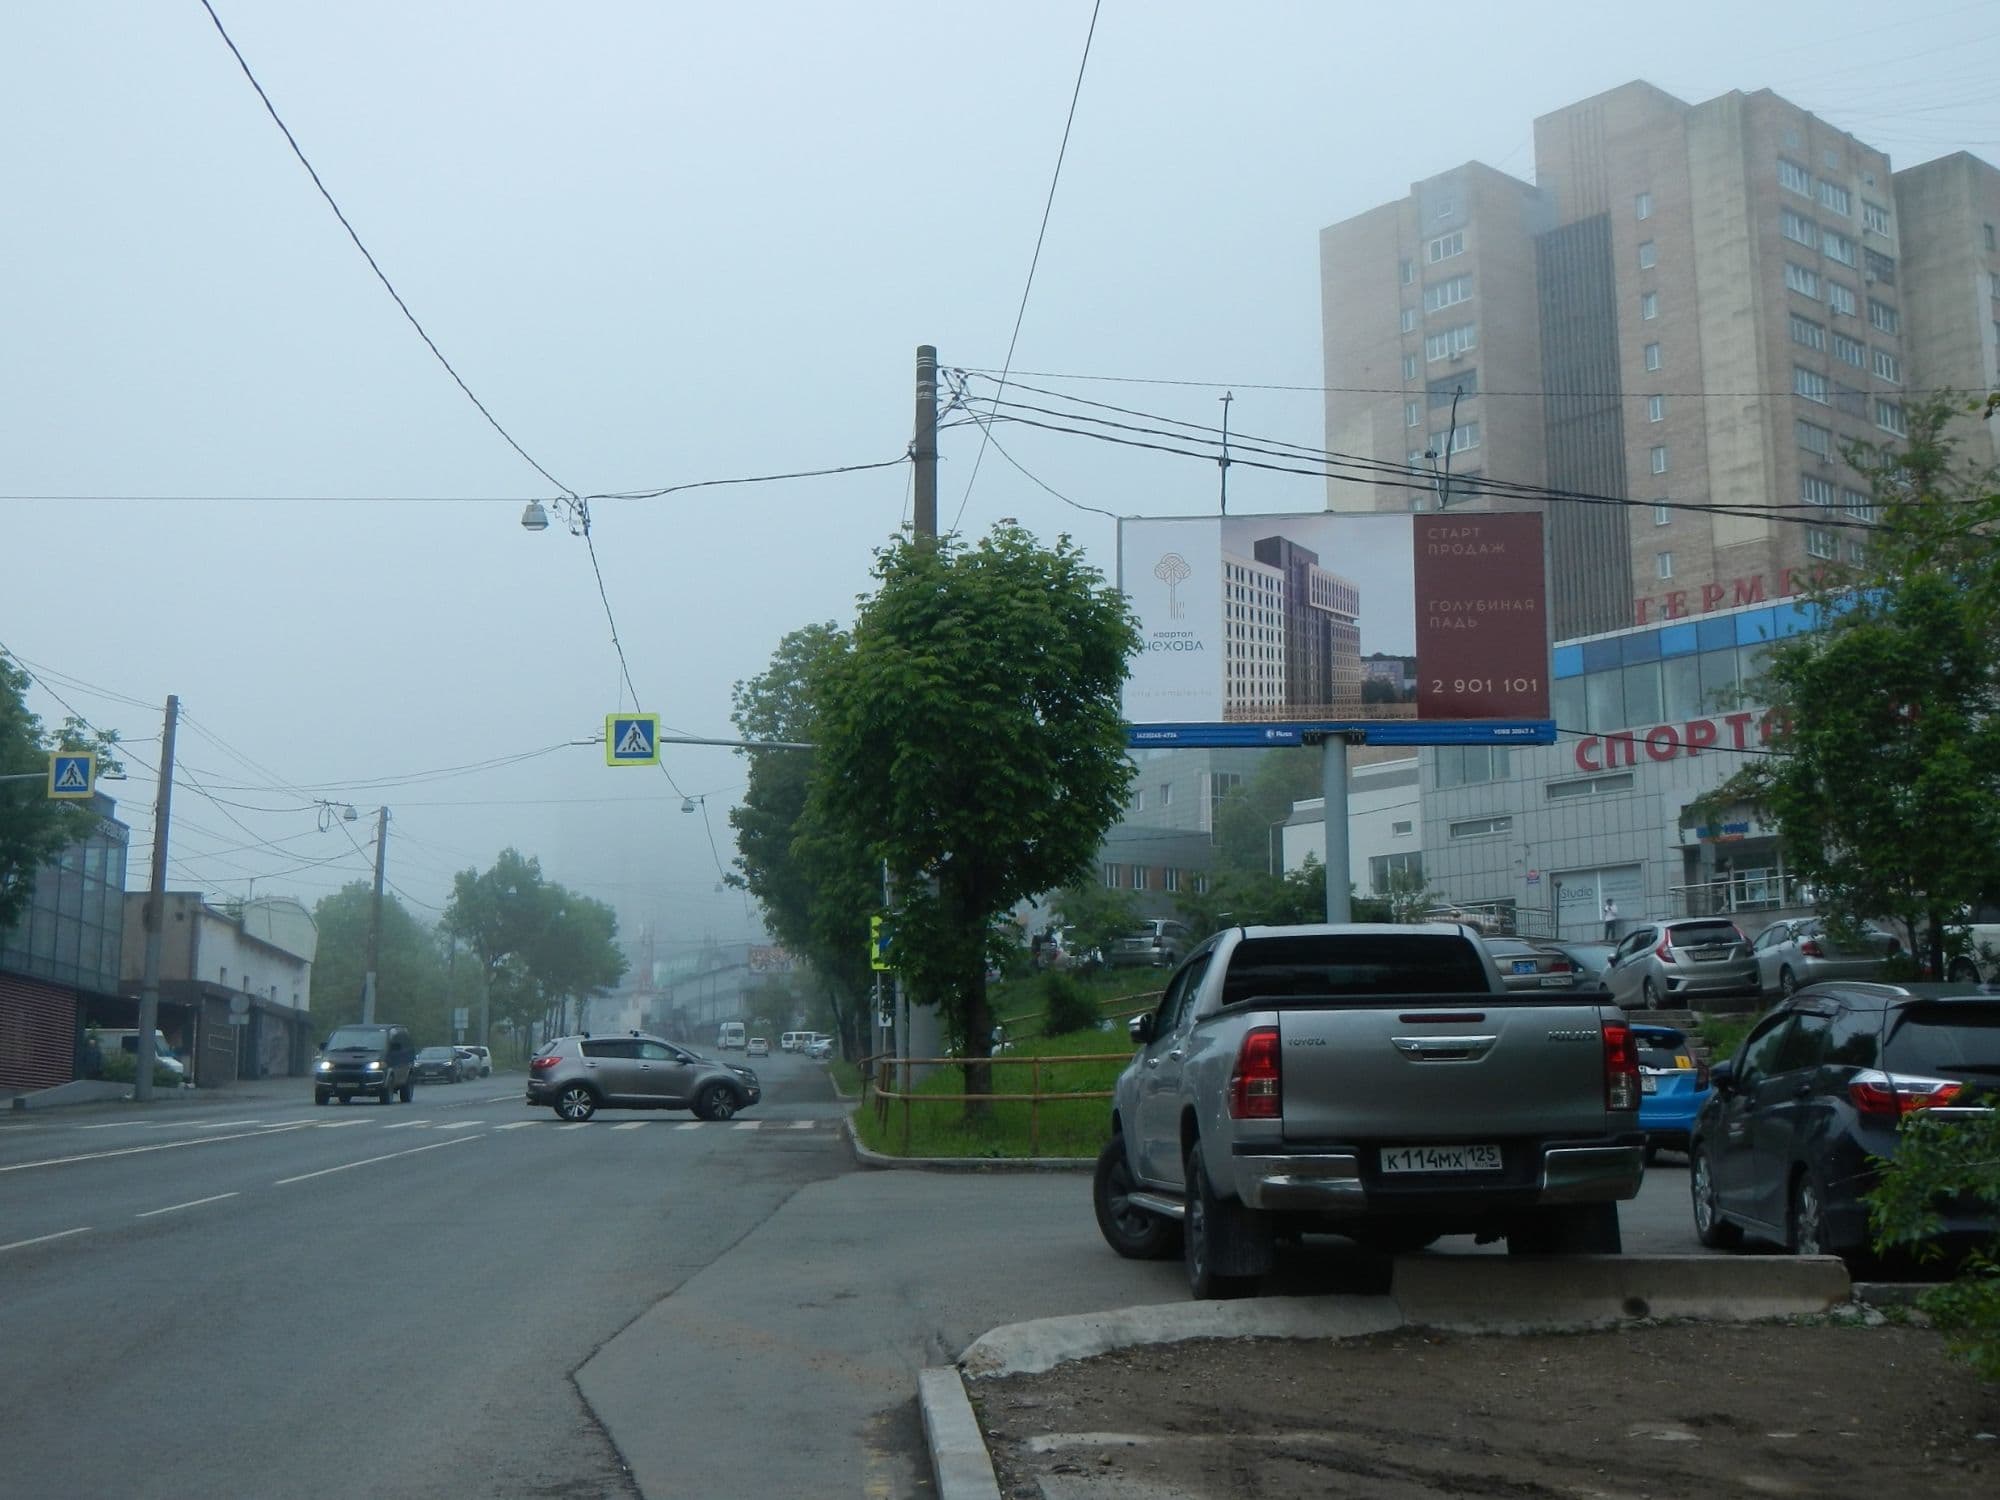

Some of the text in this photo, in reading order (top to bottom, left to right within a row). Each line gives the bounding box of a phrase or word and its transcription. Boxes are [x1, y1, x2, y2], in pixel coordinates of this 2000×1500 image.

[1427, 527, 1481, 540] СТАРТ
[1428, 543, 1505, 556] ПРОДАЖ
[1429, 599, 1536, 613] ГОЛУБИНАЯ
[1430, 616, 1478, 629] ПАДЬ
[1432, 678, 1537, 693] 2 901 101
[1468, 1146, 1496, 1162] 125
